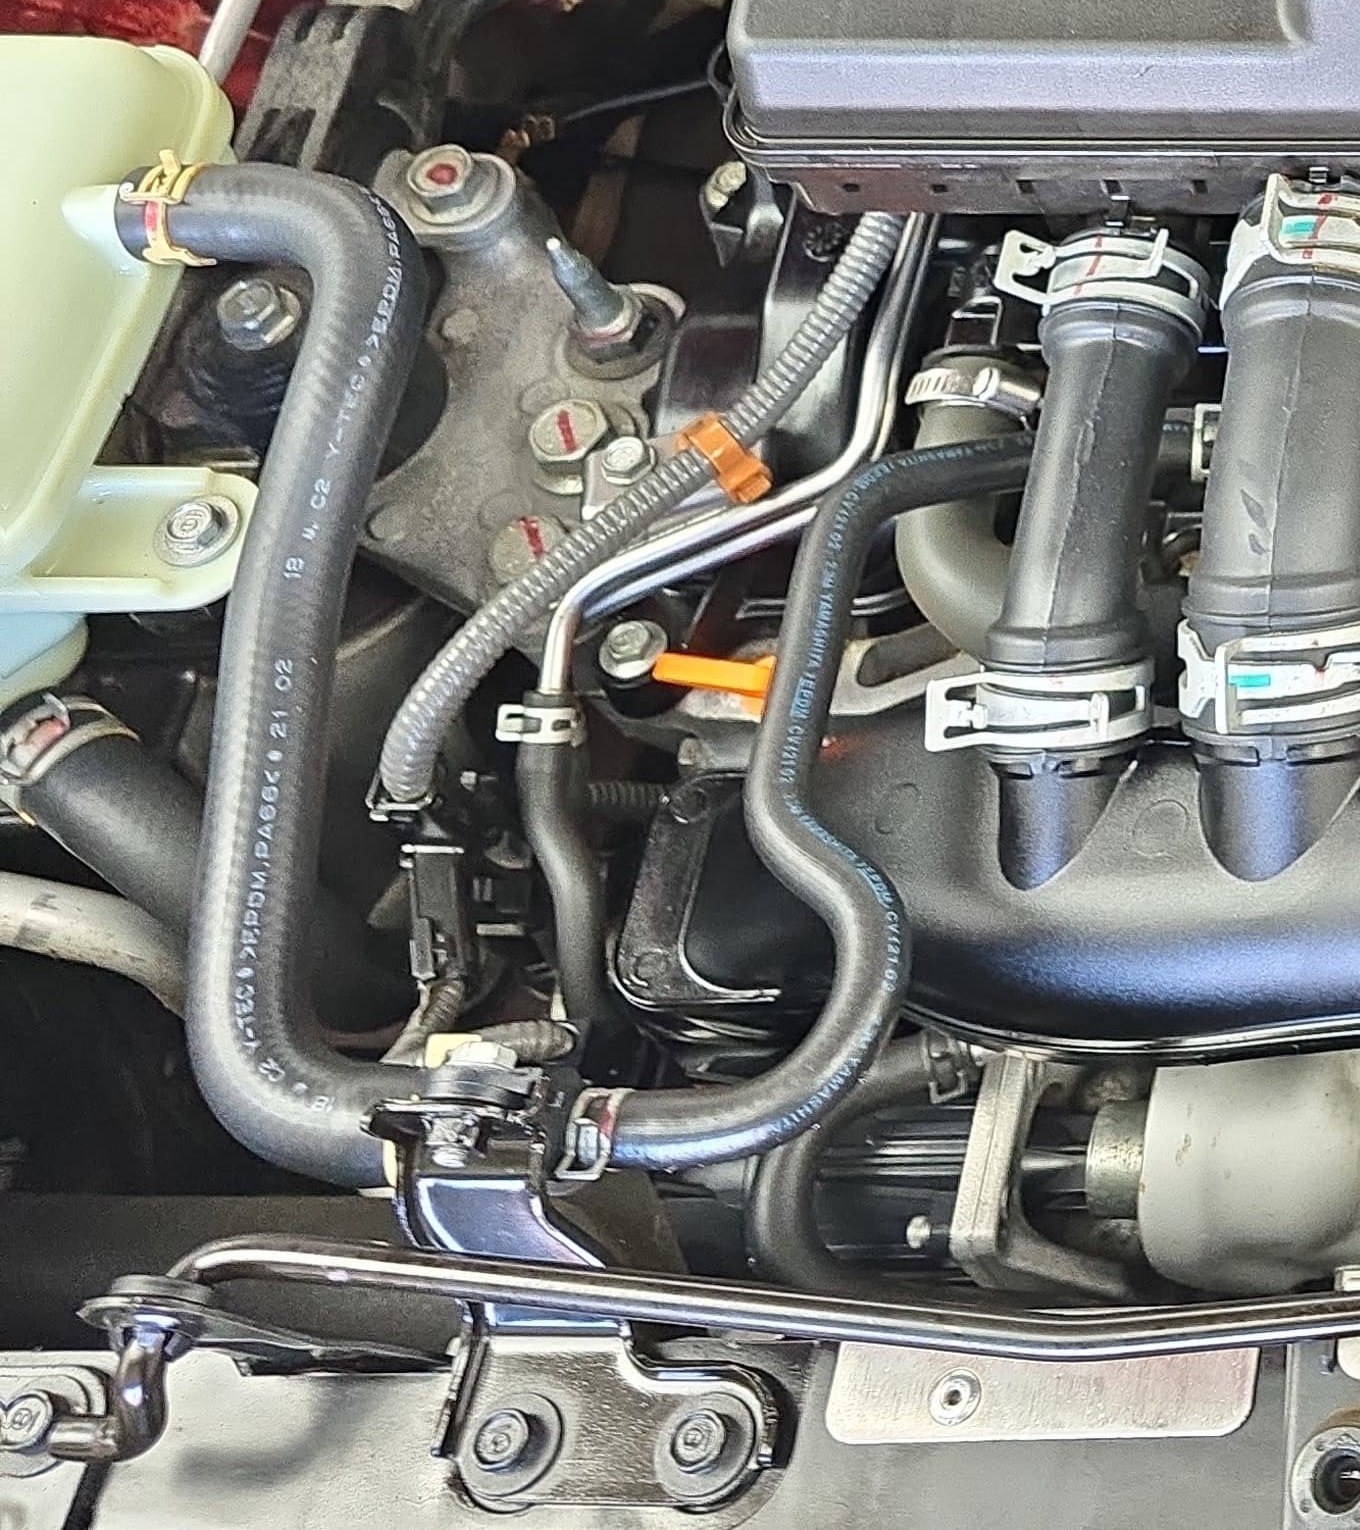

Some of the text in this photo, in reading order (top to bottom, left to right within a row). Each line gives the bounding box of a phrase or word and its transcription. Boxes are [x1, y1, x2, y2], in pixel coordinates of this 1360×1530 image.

[310, 478, 332, 510] C2
[325, 372, 366, 460] Y-TEC
[804, 591, 838, 669] YAMASHITA
[274, 658, 293, 692] 02
[270, 709, 289, 739] 21
